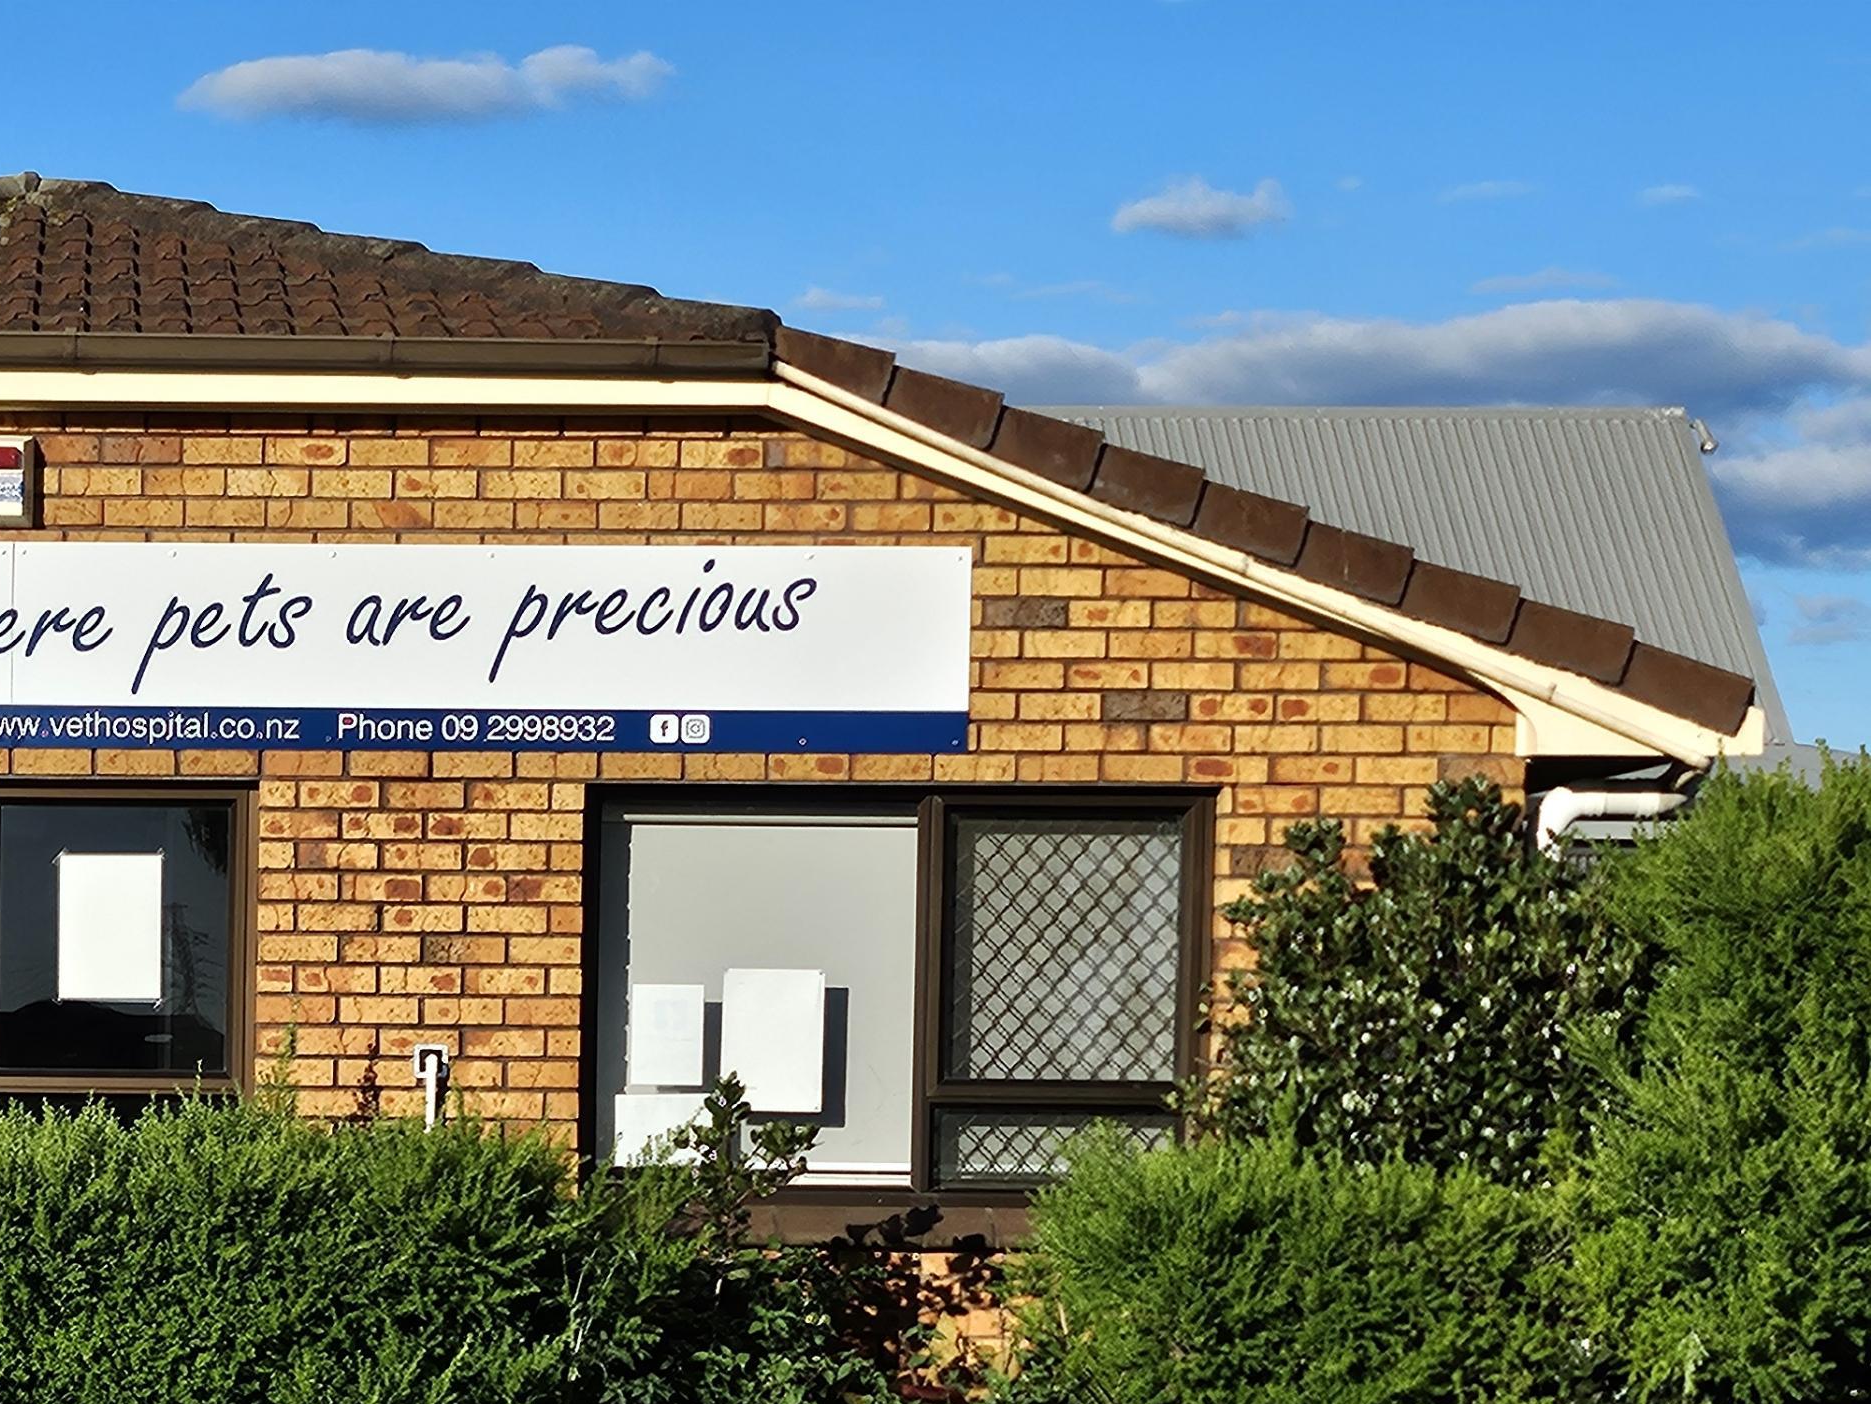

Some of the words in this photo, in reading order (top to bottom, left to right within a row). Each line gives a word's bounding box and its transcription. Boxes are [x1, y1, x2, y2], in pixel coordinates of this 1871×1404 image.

[131, 572, 313, 695] pets
[346, 594, 471, 647] are
[488, 558, 817, 684] precious
[338, 713, 433, 740] Phone
[441, 714, 479, 741] 09
[486, 713, 616, 742] 2998932
